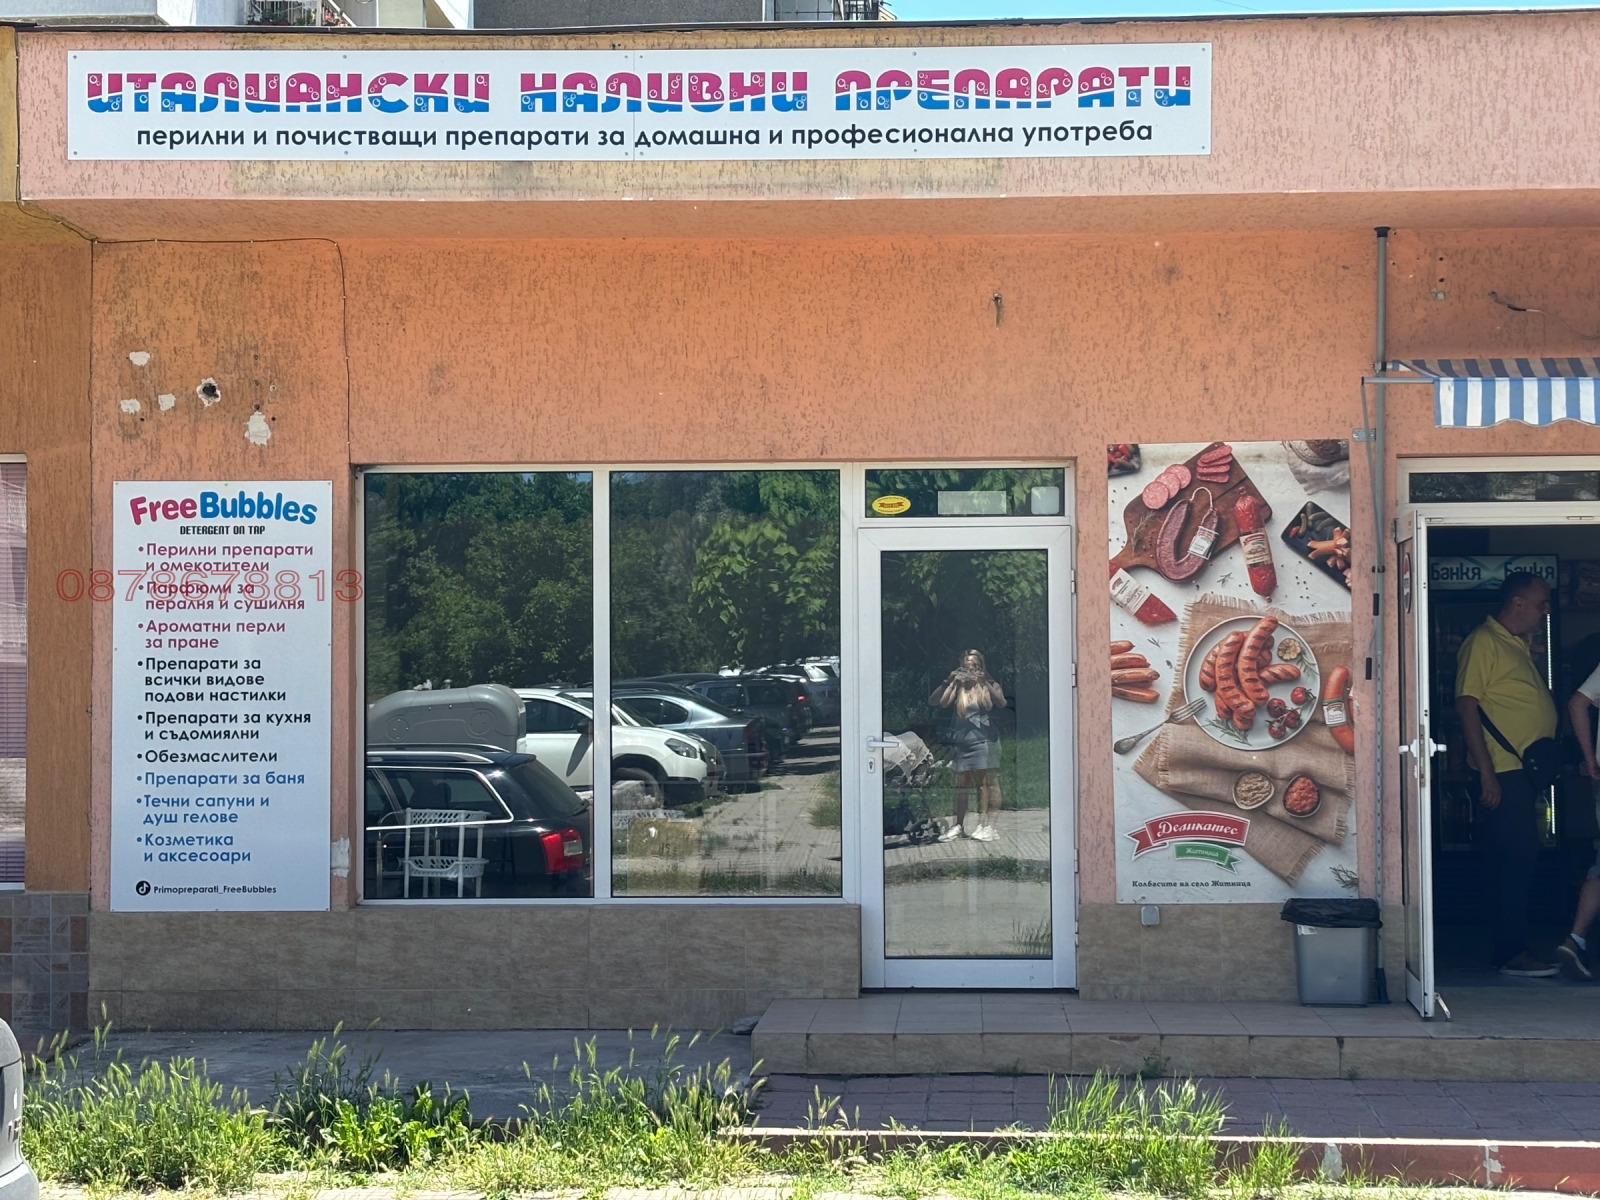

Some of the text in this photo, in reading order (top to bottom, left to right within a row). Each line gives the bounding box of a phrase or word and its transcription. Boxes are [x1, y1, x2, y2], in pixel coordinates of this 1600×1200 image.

[87, 67, 1190, 113] ИТАЛИАНСКИ НАЛИВНИ ПРЕПАРАТИ
[138, 120, 1152, 150] перилни и почистващи препарати за домашна и професионална употреба
[129, 490, 317, 525] FreeBubbles
[248, 525, 265, 534] TAP
[146, 542, 313, 558] Перилни препарати
[145, 560, 270, 571] и омекотители
[1431, 562, 1481, 580] Банкя
[145, 581, 255, 596] Парфюми за
[144, 597, 305, 612] пералня и сушилня
[145, 619, 285, 635] Ароматни перли
[145, 638, 219, 651] за пране
[145, 657, 260, 672] Препарати за
[144, 675, 264, 686] всички видове
[144, 691, 285, 703] подови настилки
[145, 711, 310, 727] Препарати за кухня
[144, 729, 259, 741] и съдомиялни
[144, 749, 277, 762] Обезмаслители
[145, 770, 304, 786] Препарати за баня
[143, 794, 269, 810] Течни сапуни и
[142, 812, 238, 826] душ гелове
[1157, 820, 1239, 838] Деликатес
[144, 833, 233, 846] Козметика
[143, 851, 250, 864] и аксесоари
[1132, 880, 1177, 888] Колбасите
[1191, 880, 1209, 888] село
[1211, 880, 1251, 888] Житница
